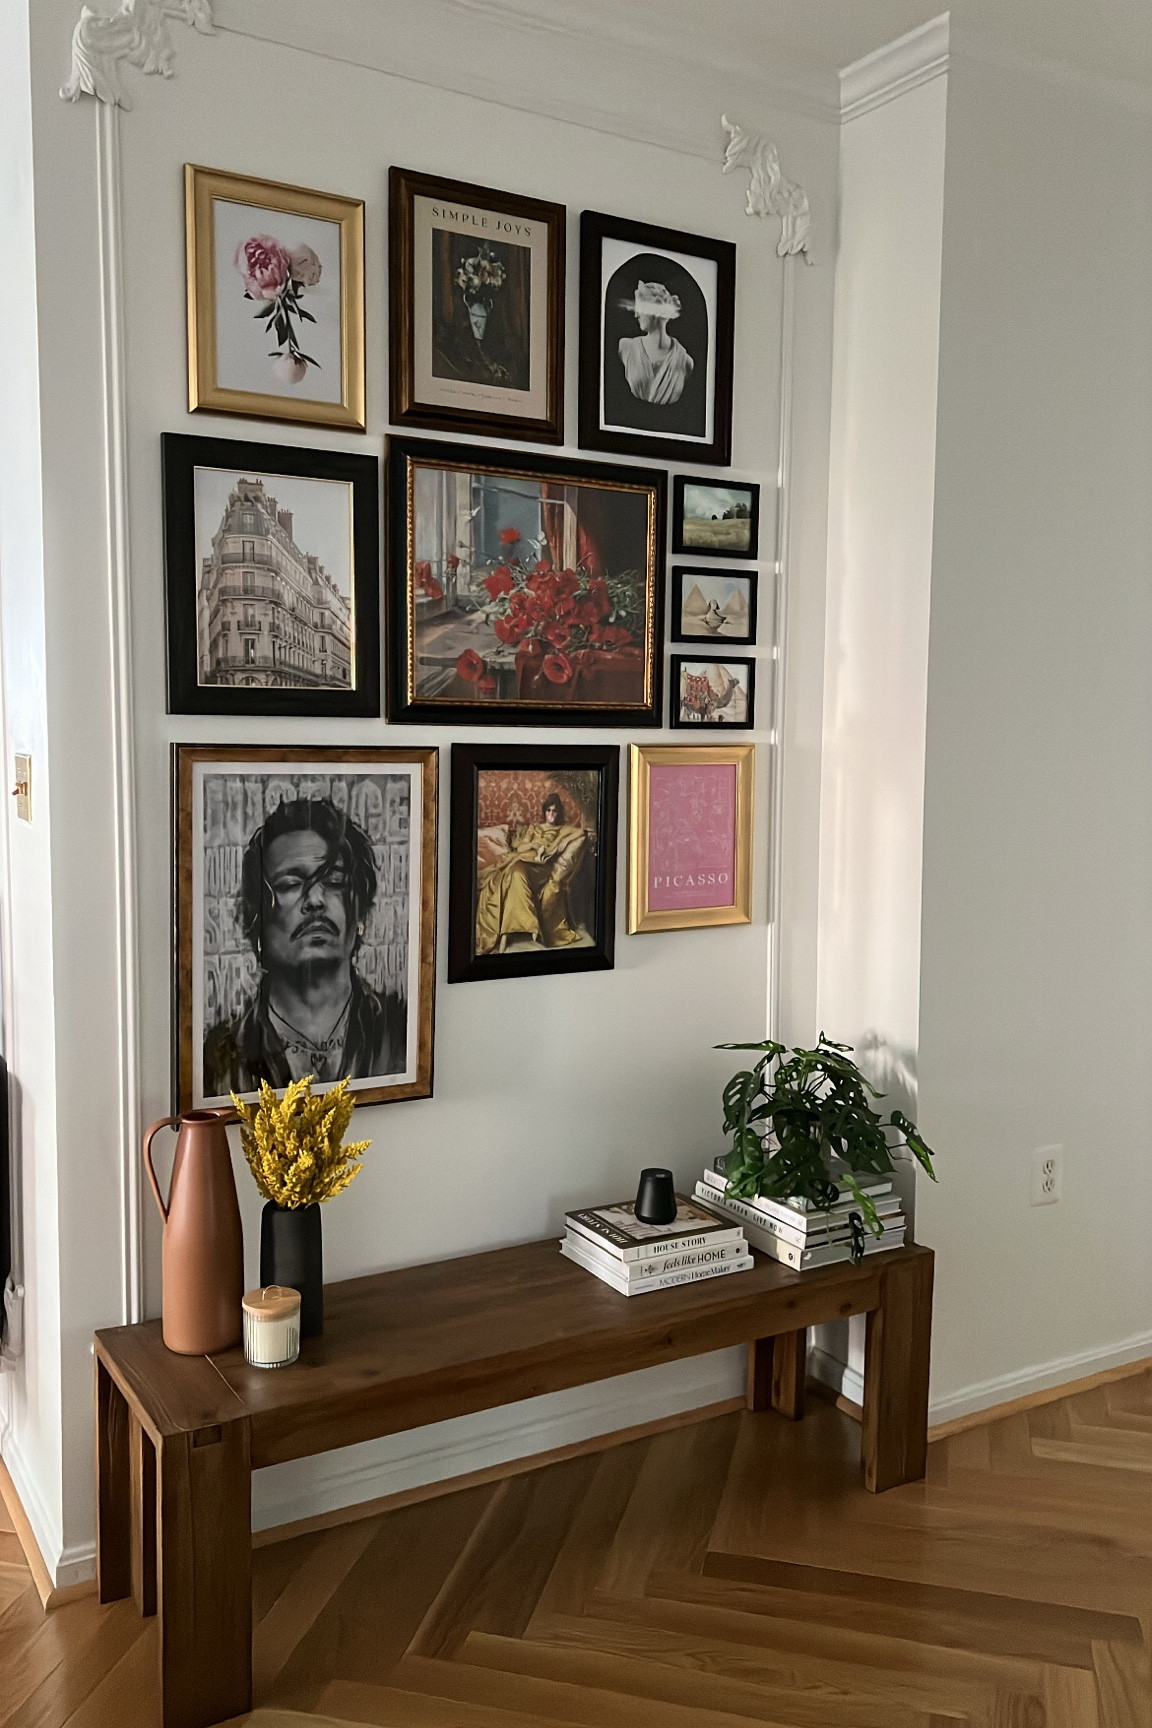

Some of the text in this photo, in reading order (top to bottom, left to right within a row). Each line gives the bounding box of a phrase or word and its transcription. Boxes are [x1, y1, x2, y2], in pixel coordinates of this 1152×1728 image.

[432, 206, 532, 236] SIMPLE JOYS
[653, 872, 729, 888] PICASSO
[701, 1187, 727, 1205] VICTORIA
[753, 1213, 767, 1226] LIVE
[653, 1237, 707, 1254] HOUSE STORY
[662, 1249, 727, 1273] feels like HOME
